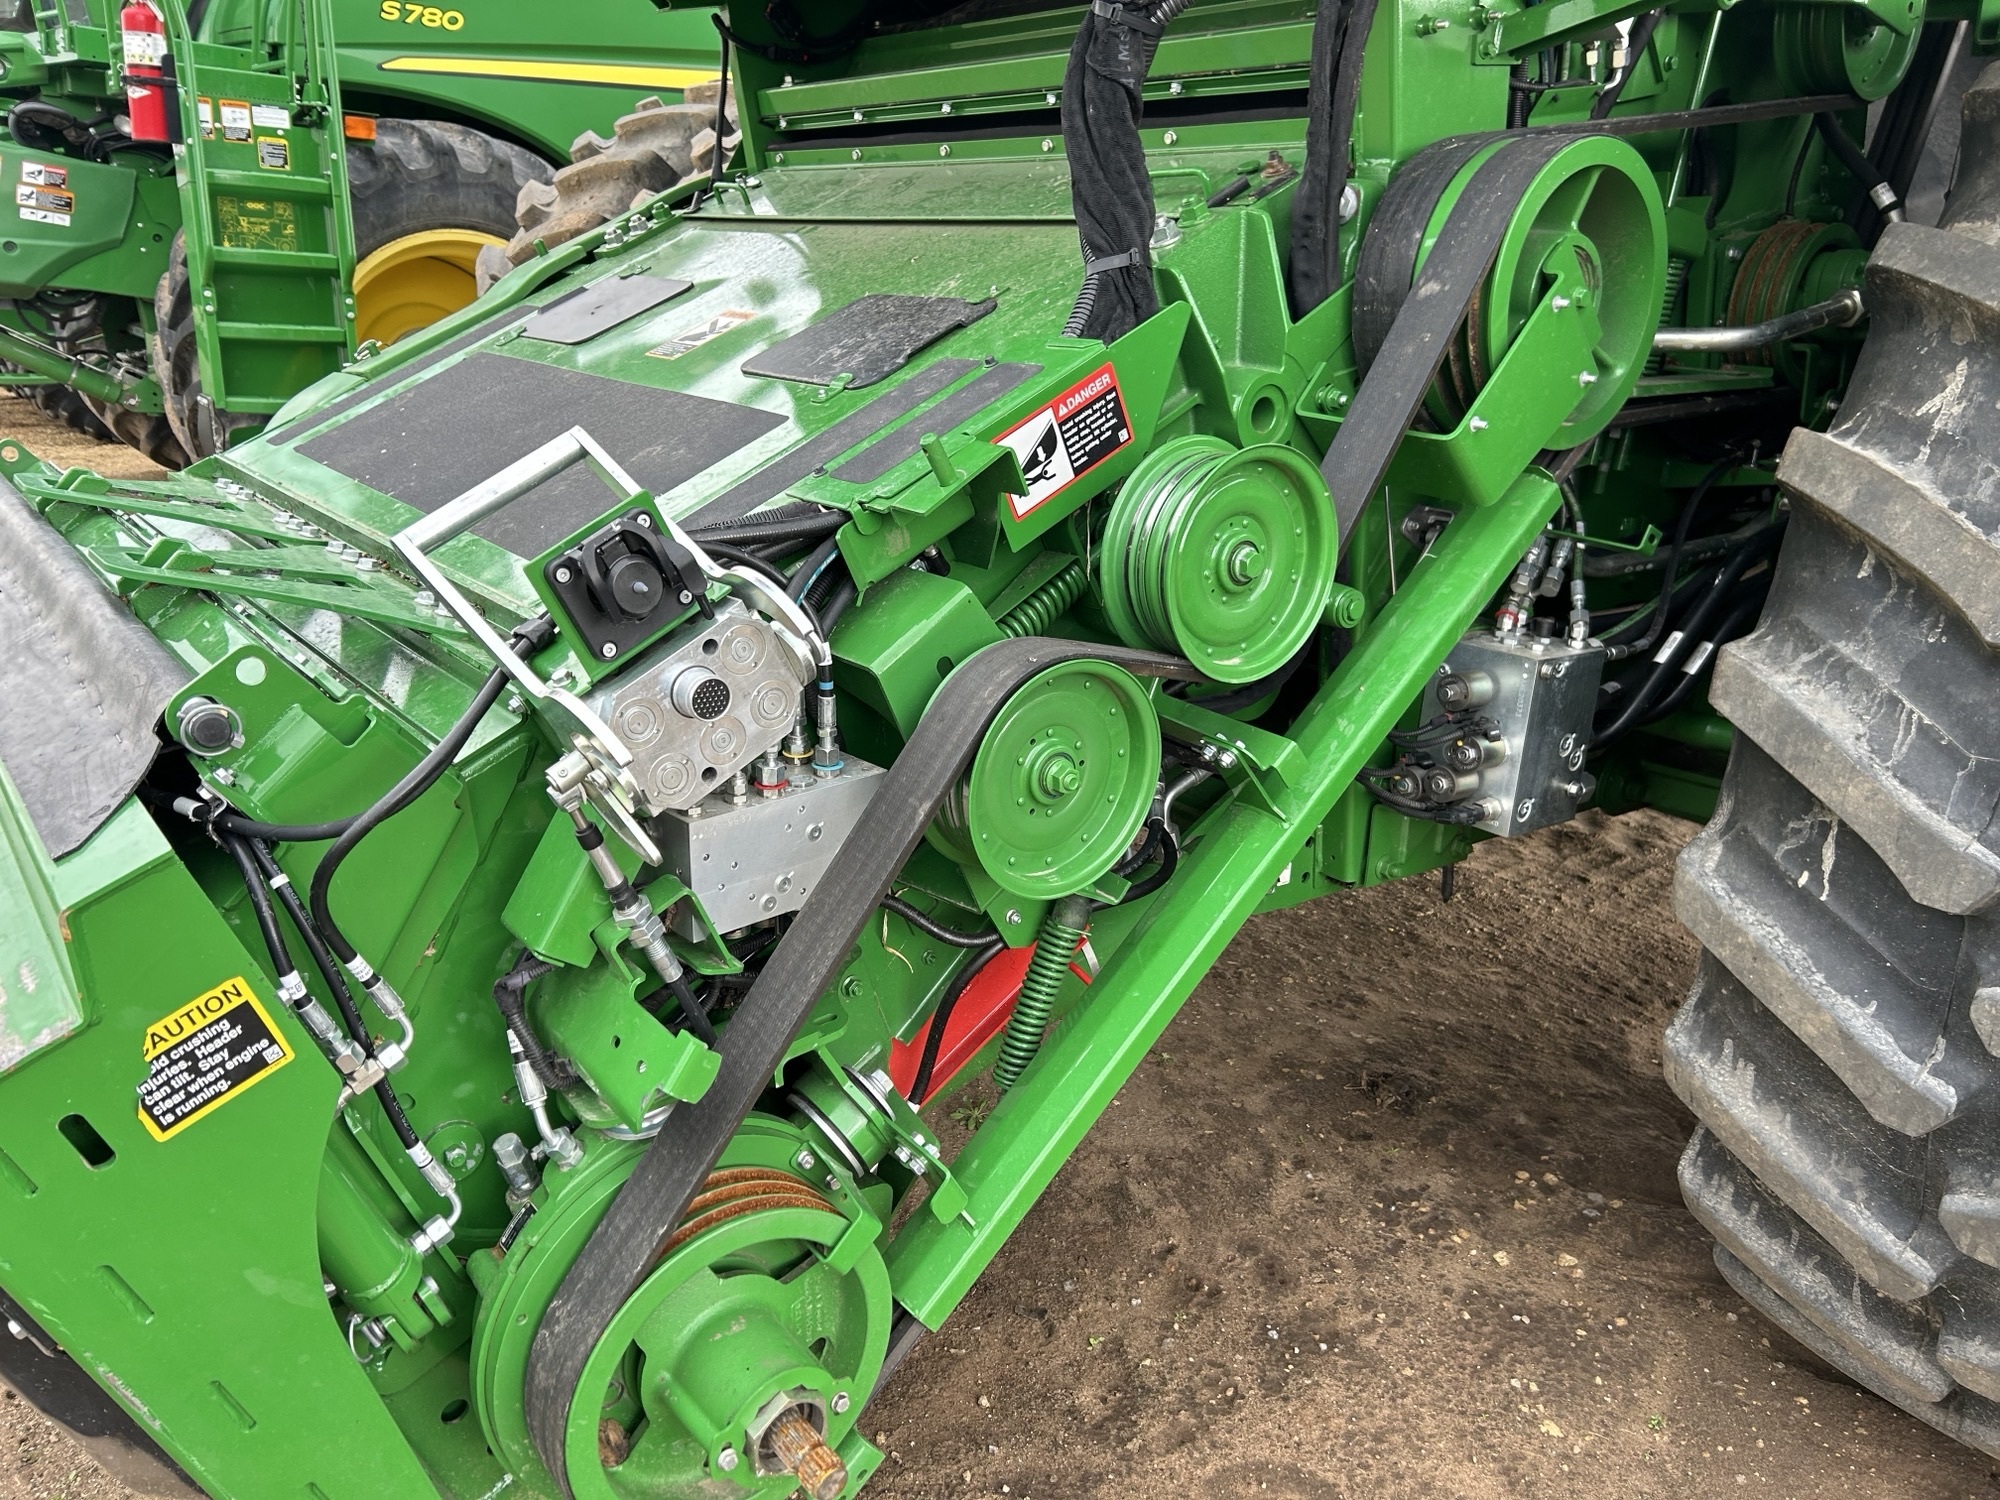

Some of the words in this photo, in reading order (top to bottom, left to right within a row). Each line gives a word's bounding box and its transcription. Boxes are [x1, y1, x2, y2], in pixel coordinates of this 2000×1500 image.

[380, 0, 465, 31] S780
[1066, 373, 1111, 410] DANGER
[1074, 408, 1093, 423] crushing
[1086, 410, 1101, 425] ground
[1090, 415, 1106, 429] located
[1085, 439, 1100, 452] getting
[1100, 430, 1112, 441] under
[273, 865, 300, 905] exeeds
[144, 983, 243, 1057] AUTION
[170, 1019, 231, 1060] crushing
[194, 1024, 243, 1059] Header
[144, 1086, 171, 1106] can
[170, 1070, 195, 1089] tilt.
[198, 1048, 229, 1072] Stay
[152, 1089, 186, 1116] clear
[186, 1066, 225, 1094] when
[225, 1038, 270, 1071] engine
[175, 1079, 232, 1117] running.
